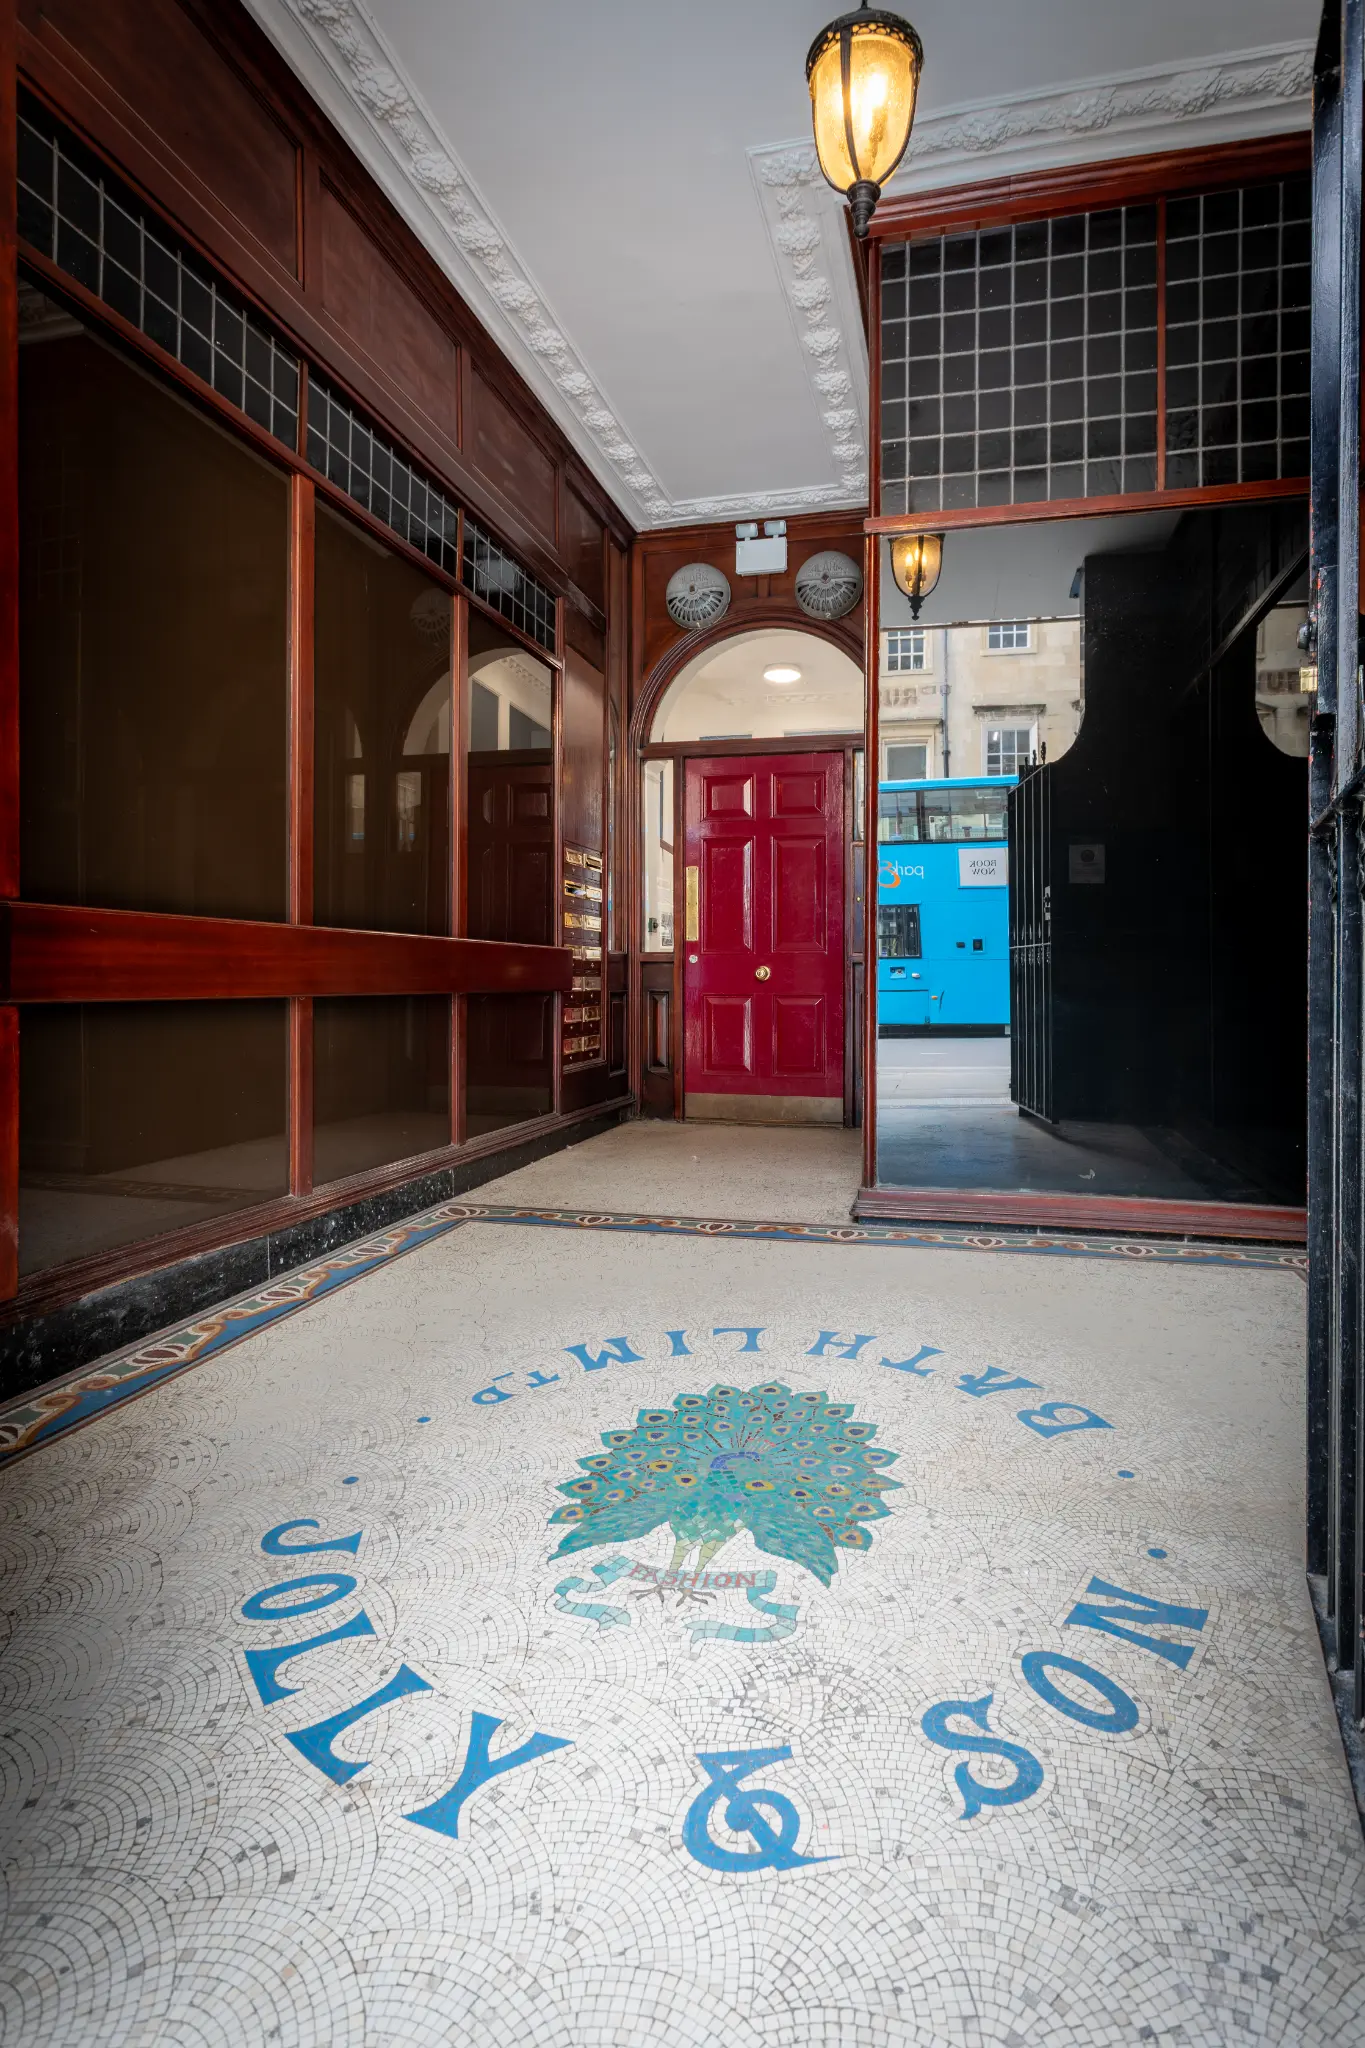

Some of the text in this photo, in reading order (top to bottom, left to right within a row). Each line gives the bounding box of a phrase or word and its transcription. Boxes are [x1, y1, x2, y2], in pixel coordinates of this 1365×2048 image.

[804, 1330, 1115, 1439] BATH
[628, 1563, 757, 1588] FASHION
[241, 1518, 573, 1840] JOLLY
[921, 1576, 1209, 1820] SON
[682, 1745, 840, 1873] &
